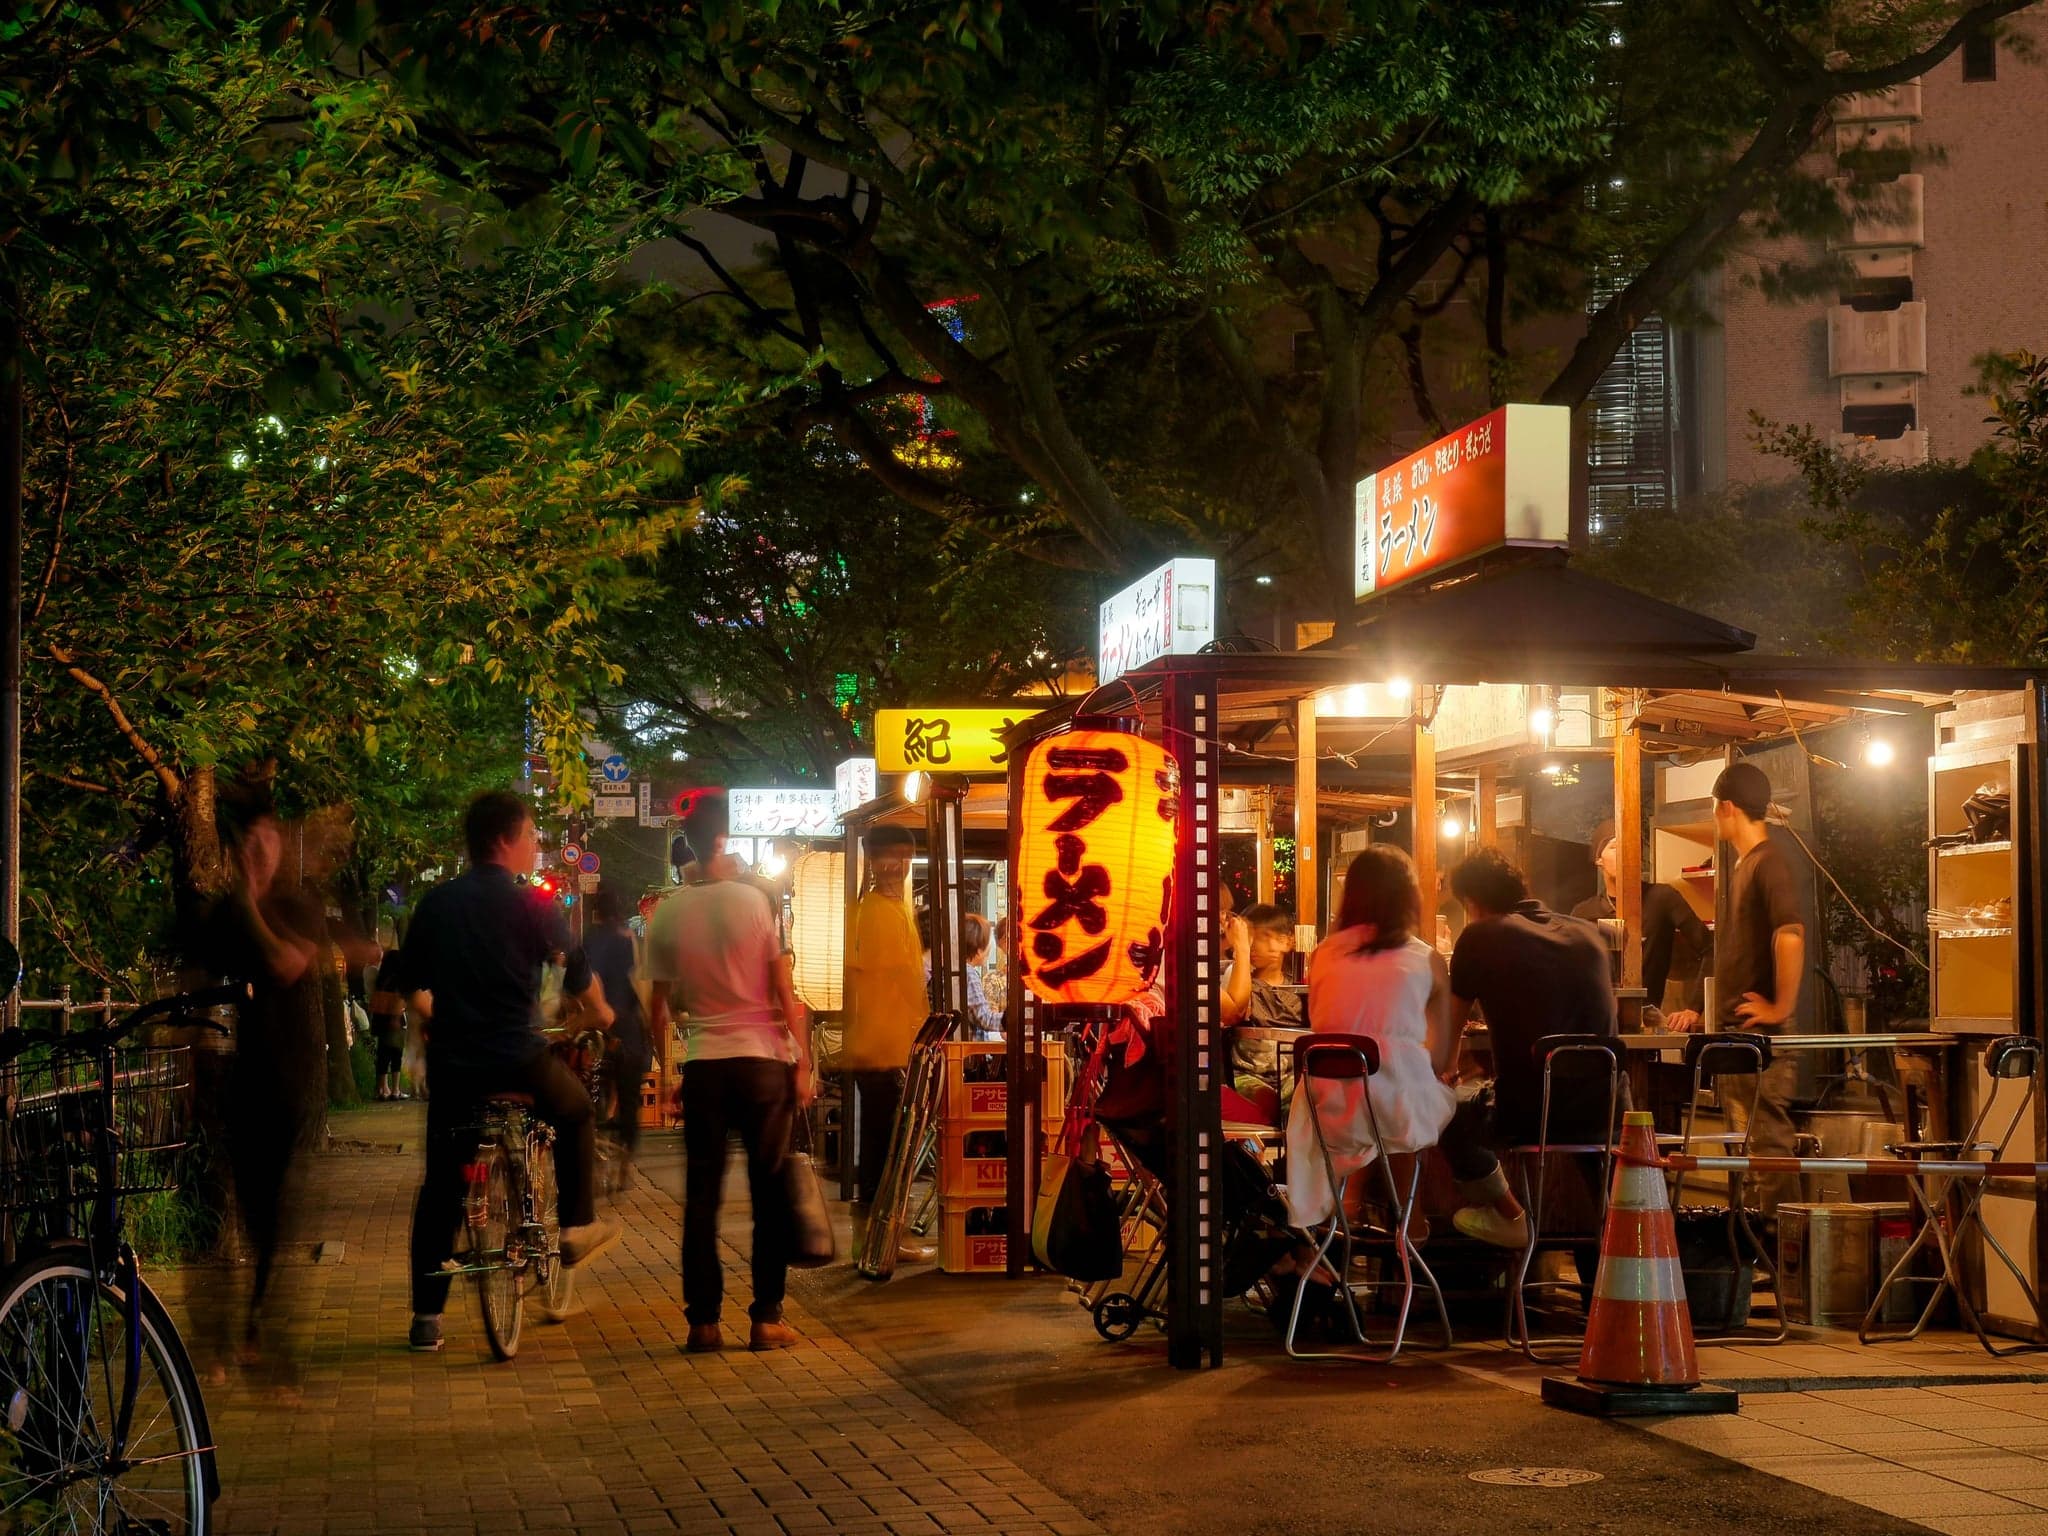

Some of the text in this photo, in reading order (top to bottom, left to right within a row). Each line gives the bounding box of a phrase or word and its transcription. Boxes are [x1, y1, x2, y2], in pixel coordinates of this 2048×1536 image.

[1382, 470, 1403, 509] 長浜
[1379, 494, 1438, 577] ラーメン
[768, 808, 829, 833] ラーメン
[1027, 746, 1128, 991] ラーメン
